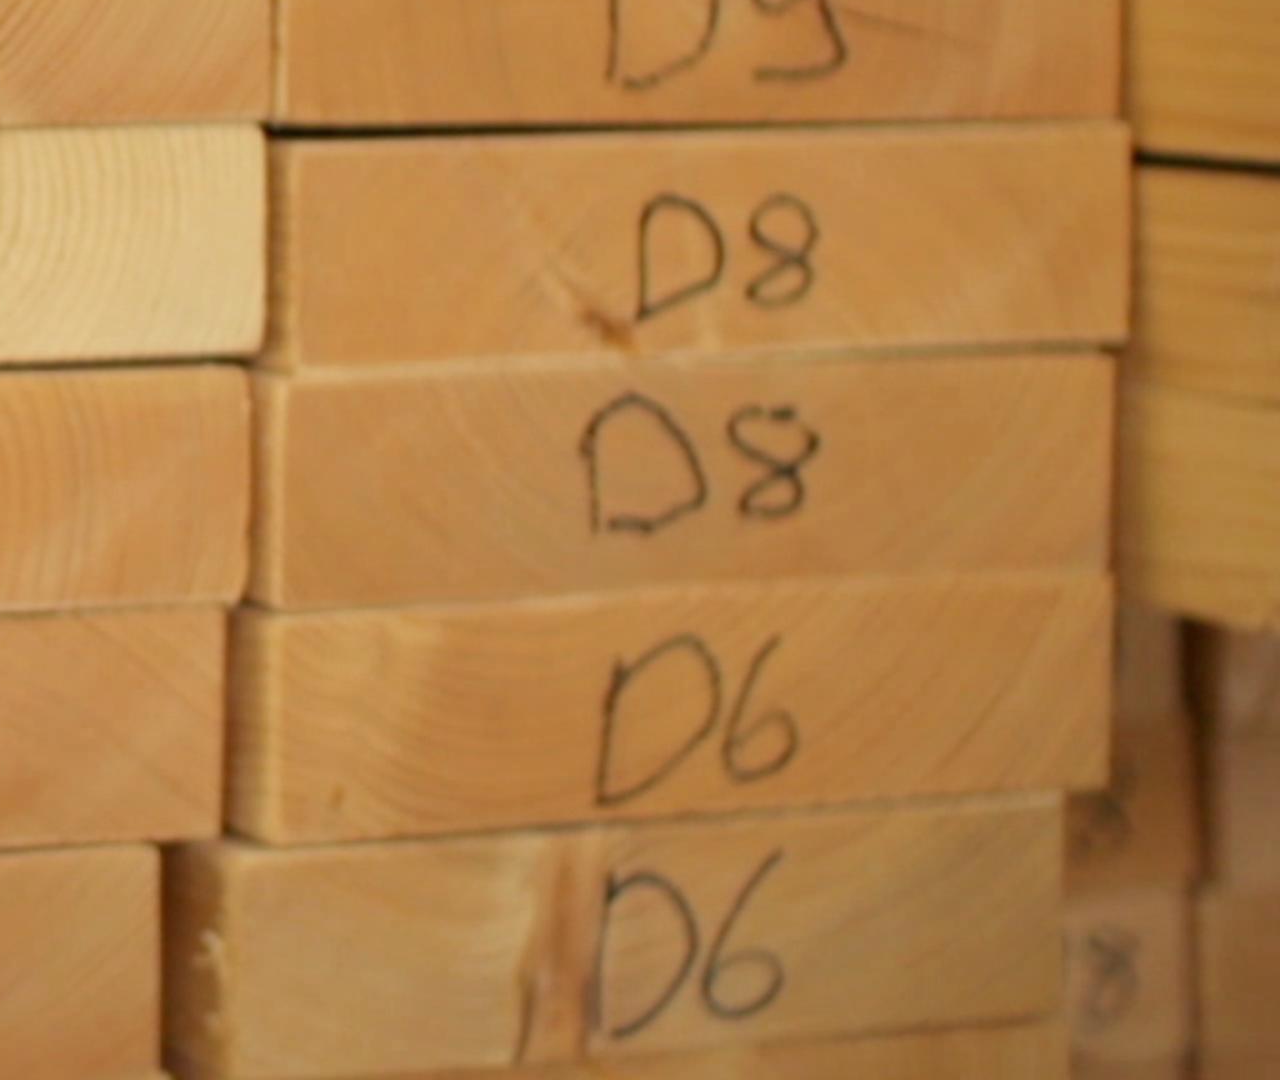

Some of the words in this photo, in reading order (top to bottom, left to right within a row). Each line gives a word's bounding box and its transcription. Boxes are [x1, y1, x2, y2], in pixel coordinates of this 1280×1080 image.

[637, 191, 819, 322] D8
[579, 391, 820, 535] D8
[595, 634, 800, 806] D6
[590, 849, 784, 1040] D6
